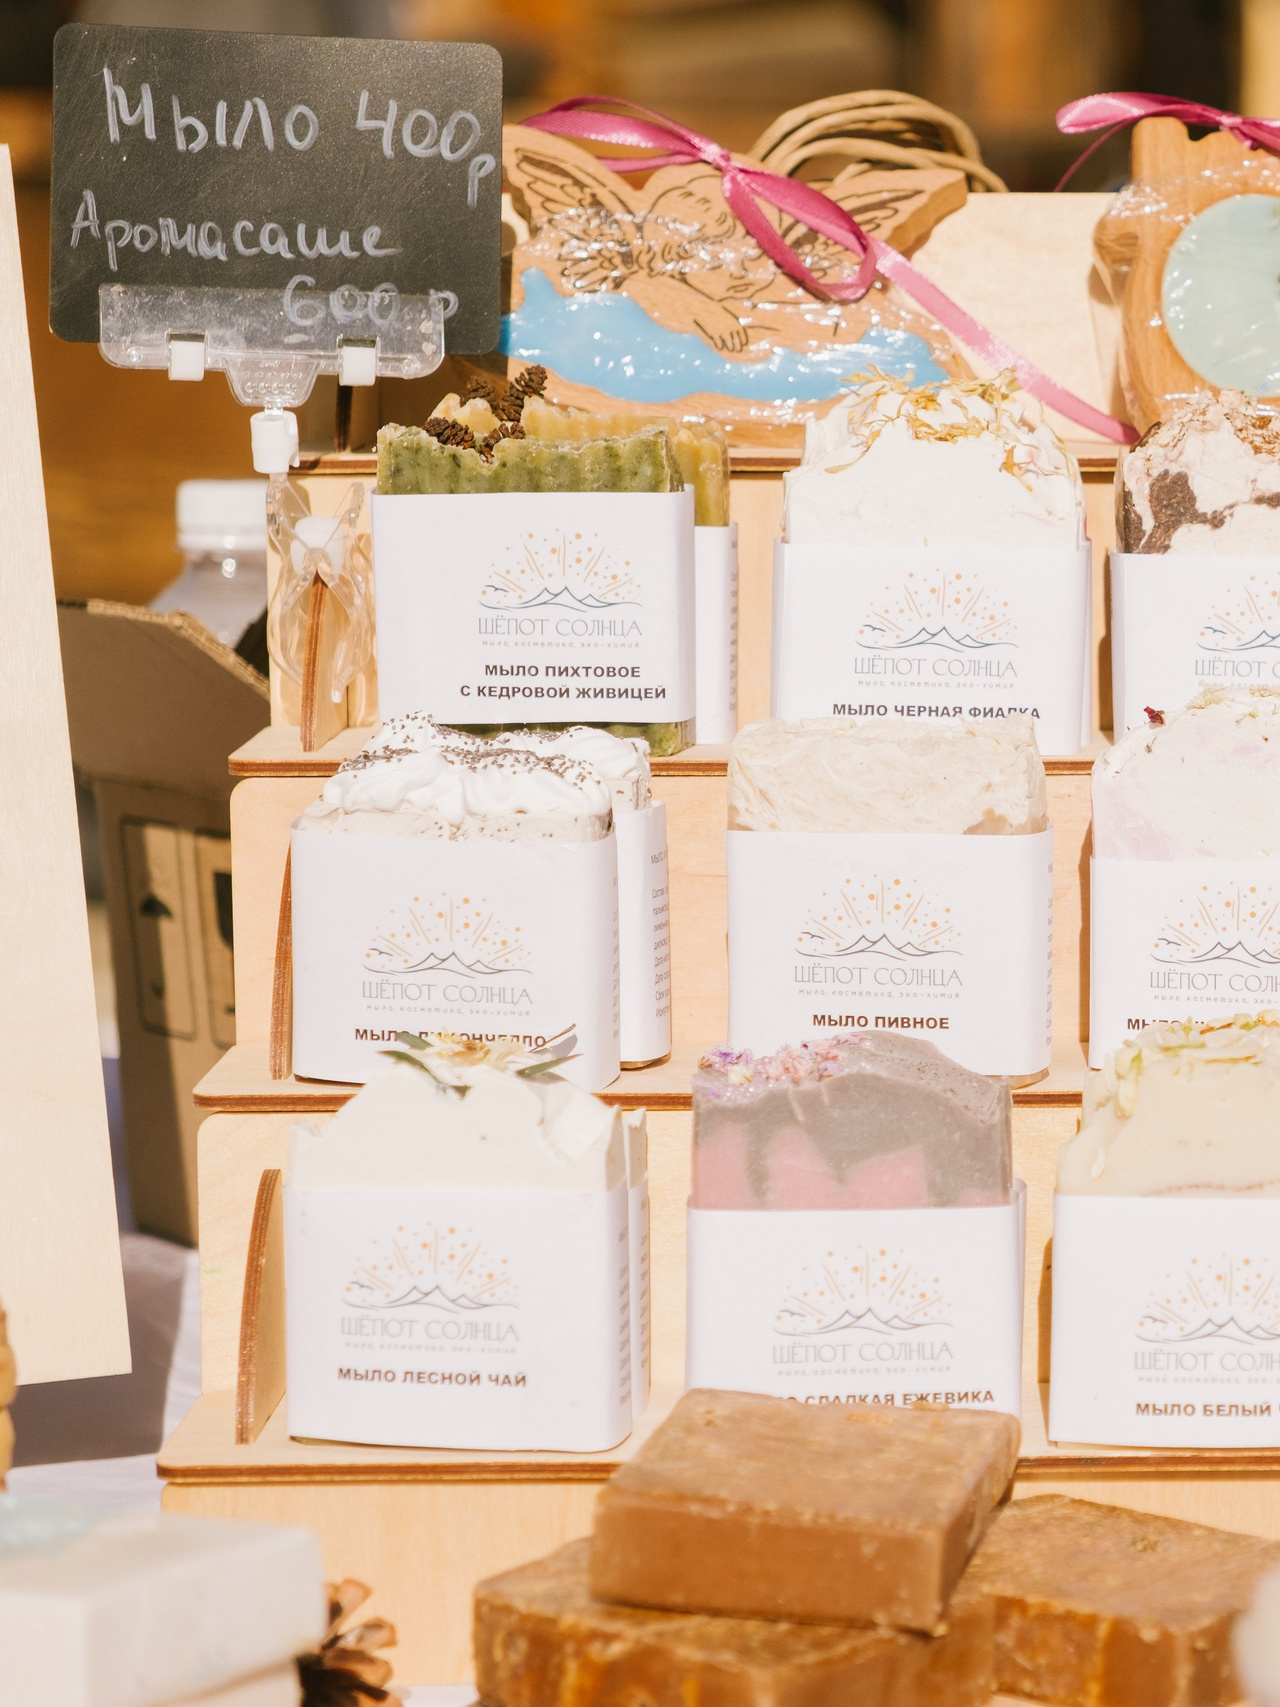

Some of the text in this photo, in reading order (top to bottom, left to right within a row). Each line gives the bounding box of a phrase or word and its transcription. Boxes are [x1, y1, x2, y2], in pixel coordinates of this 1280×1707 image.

[103, 66, 319, 153] Мыло
[71, 189, 401, 270] Аромасаше
[282, 274, 399, 326] 600
[478, 615, 642, 638] ШЁПОТ СОЛНЦА
[484, 664, 641, 678] МЫЛО ПИХТОВОЕ
[854, 654, 1018, 678] ШЁПОТ СОЛНЦА
[1195, 656, 1267, 677] ШЁПОТ
[460, 684, 667, 701] С КЕДРОВОЙ ЖИВИЦЕЙ
[832, 703, 888, 716] МЫЛО
[894, 705, 963, 718] ЧЕРНАЯ
[794, 963, 963, 987] ШЁПОТ СОЛНЦА
[1150, 969, 1223, 991] ШЁПОТ
[362, 979, 533, 1006] ШЁПОТ СОЛНЦА
[813, 1014, 949, 1029] МЫЛО ПИВНОЕ
[355, 1028, 410, 1042] МЫЛ
[341, 1315, 520, 1342] ШЁПОТ СОЛНЦА
[772, 1342, 954, 1364] ШЁПОТ СОЛНЦА
[1134, 1349, 1214, 1371] ШЁПОТ
[338, 1367, 527, 1388] МЫЛО ЛЕСНОЙ ЧАЙ
[902, 1390, 995, 1406] ЕЖЕВИКА
[1135, 1402, 1196, 1416] МЫЛО
[1203, 1401, 1272, 1417] БЕЛЫЙ
